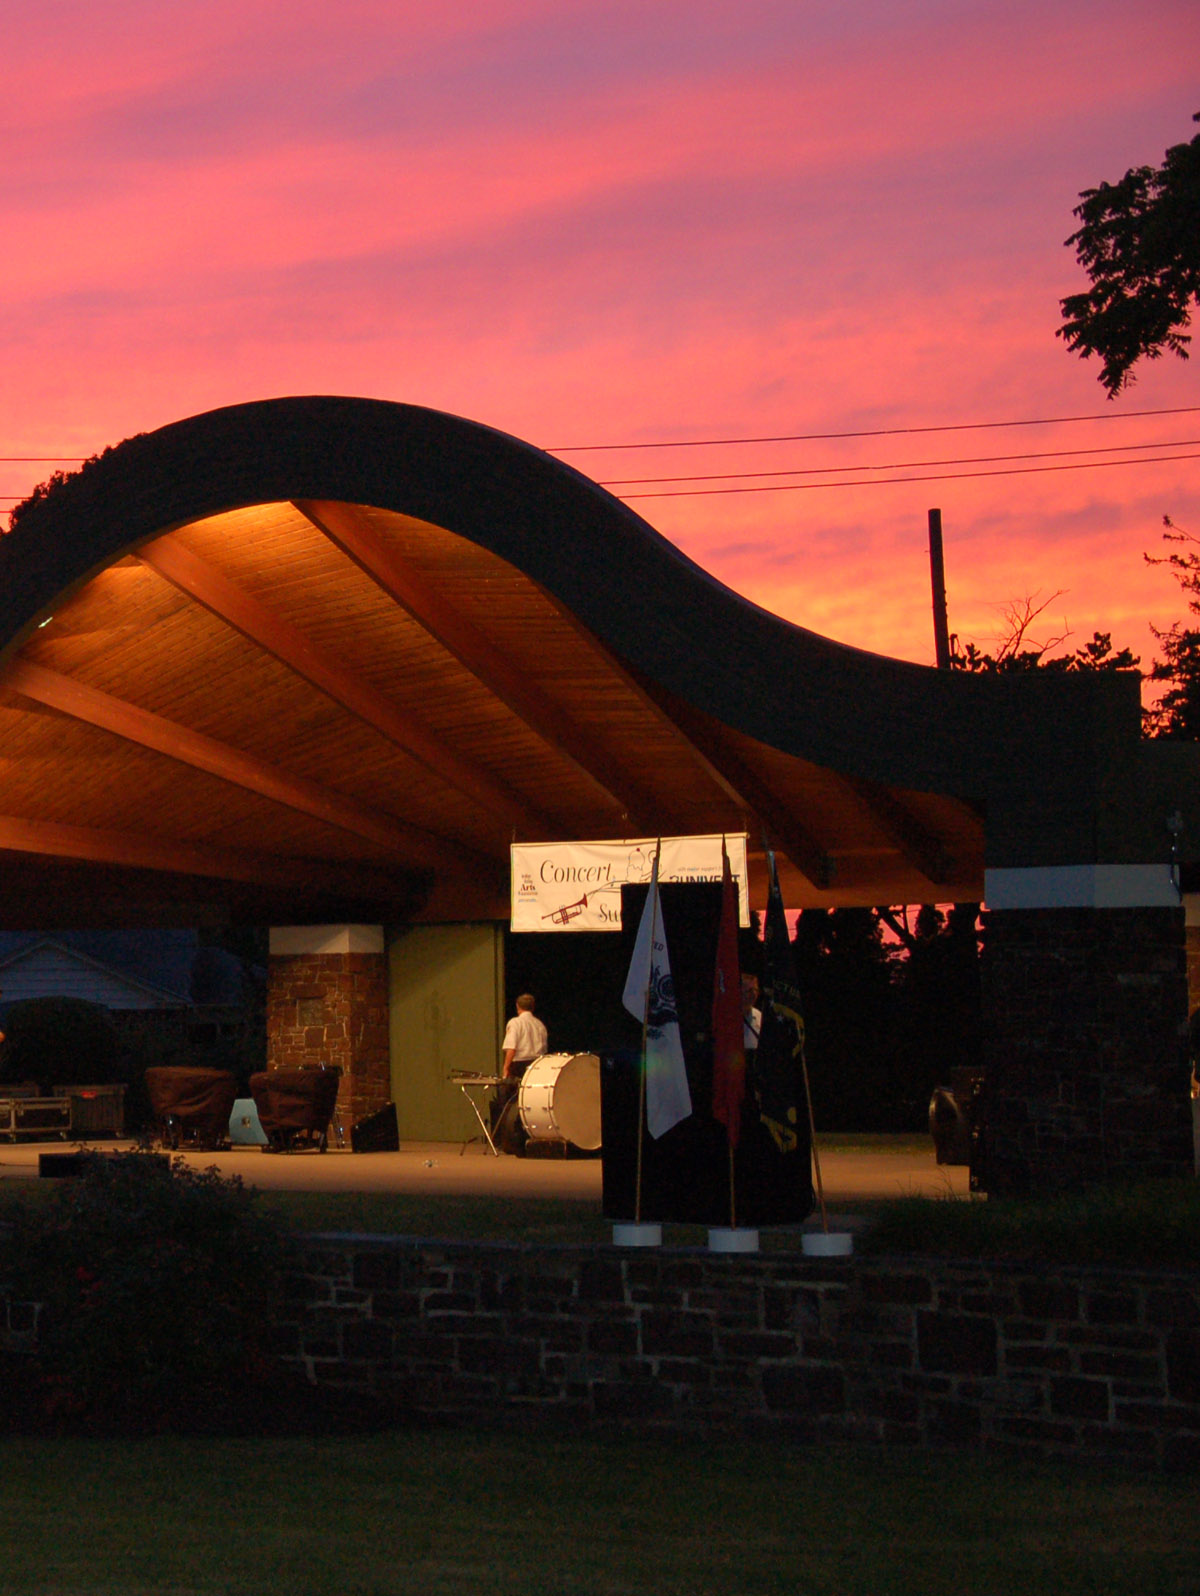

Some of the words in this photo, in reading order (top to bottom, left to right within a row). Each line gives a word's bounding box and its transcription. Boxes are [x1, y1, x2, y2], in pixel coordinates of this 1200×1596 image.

[540, 860, 612, 884] Concert
[681, 874, 740, 883] UNIVET
[520, 883, 536, 891] Arts
